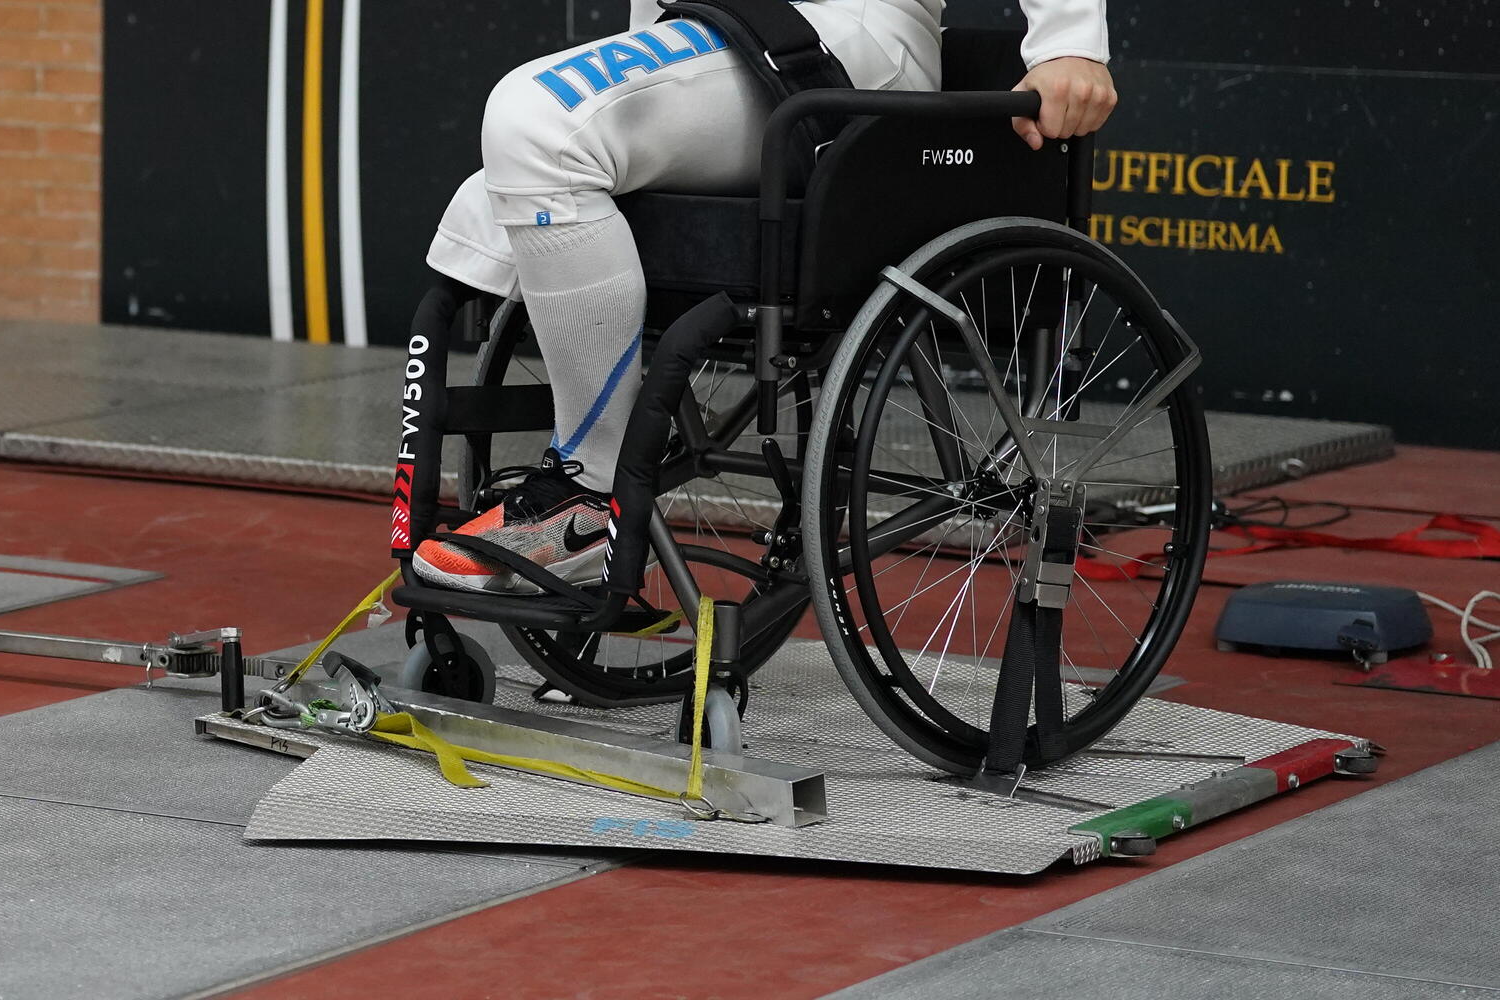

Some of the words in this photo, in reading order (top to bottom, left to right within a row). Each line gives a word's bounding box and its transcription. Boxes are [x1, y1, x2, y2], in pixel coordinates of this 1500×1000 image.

[922, 148, 974, 166] FW500
[1092, 150, 1336, 203] UFFICIALE
[1120, 215, 1283, 254] SCHERMA
[398, 334, 430, 460] FW500
